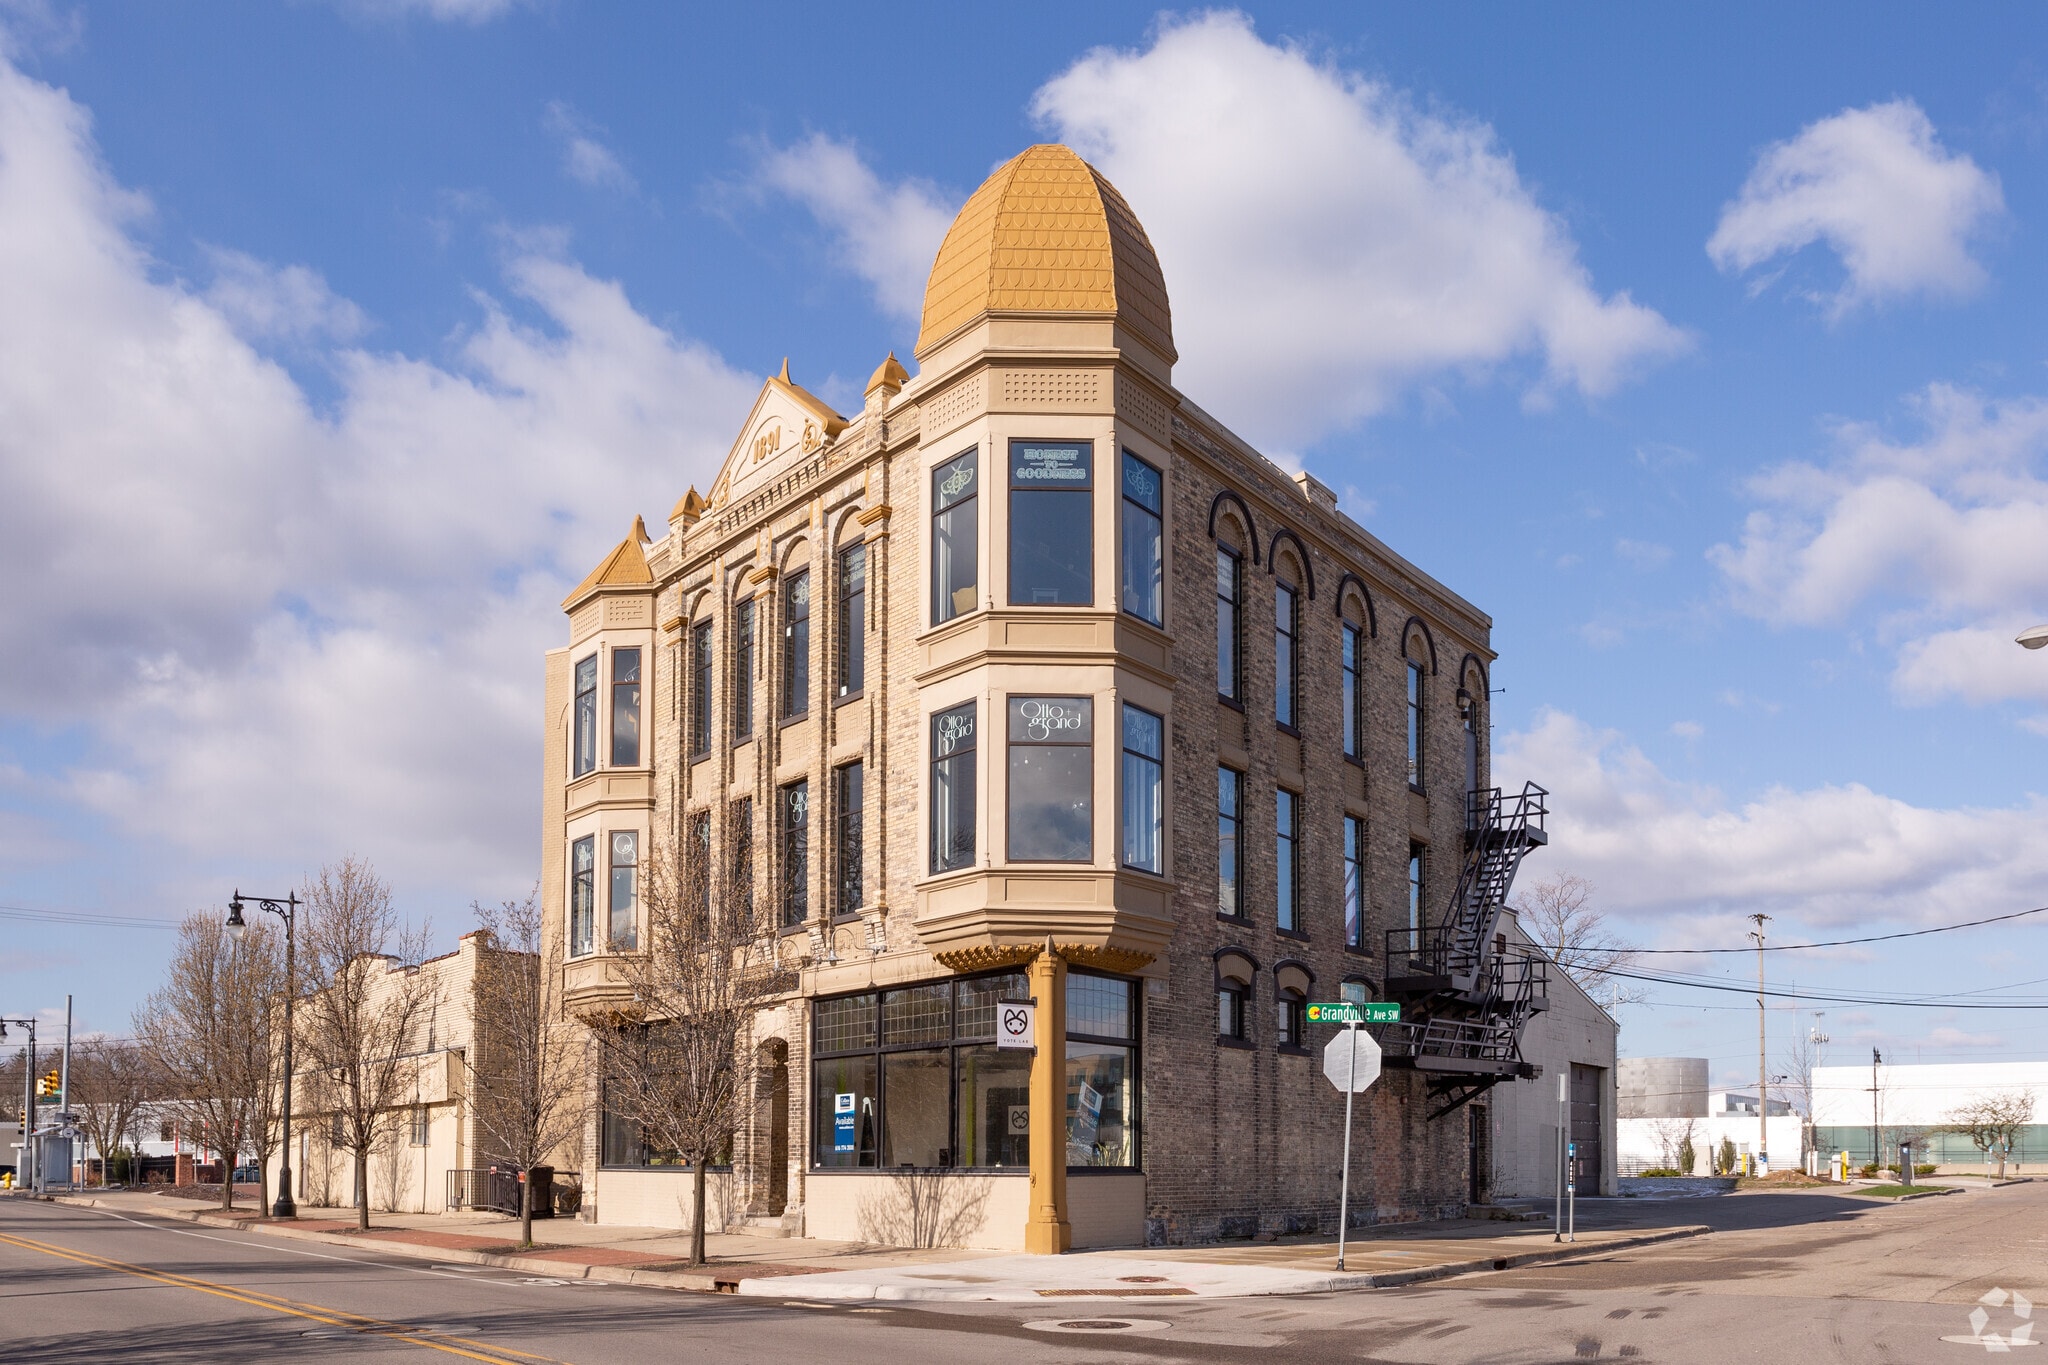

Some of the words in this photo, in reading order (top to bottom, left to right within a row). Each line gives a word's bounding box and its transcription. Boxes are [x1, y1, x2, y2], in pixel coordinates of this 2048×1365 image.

[753, 424, 780, 464] 1891
[1023, 448, 1078, 460] HONEST
[1044, 460, 1058, 469] TO
[1016, 468, 1086, 479] GOODNESS
[1028, 713, 1080, 741] grand
[1321, 1006, 1371, 1020] Grandville
[1373, 1010, 1386, 1020] Ave
[1388, 1010, 1399, 1020] SW
